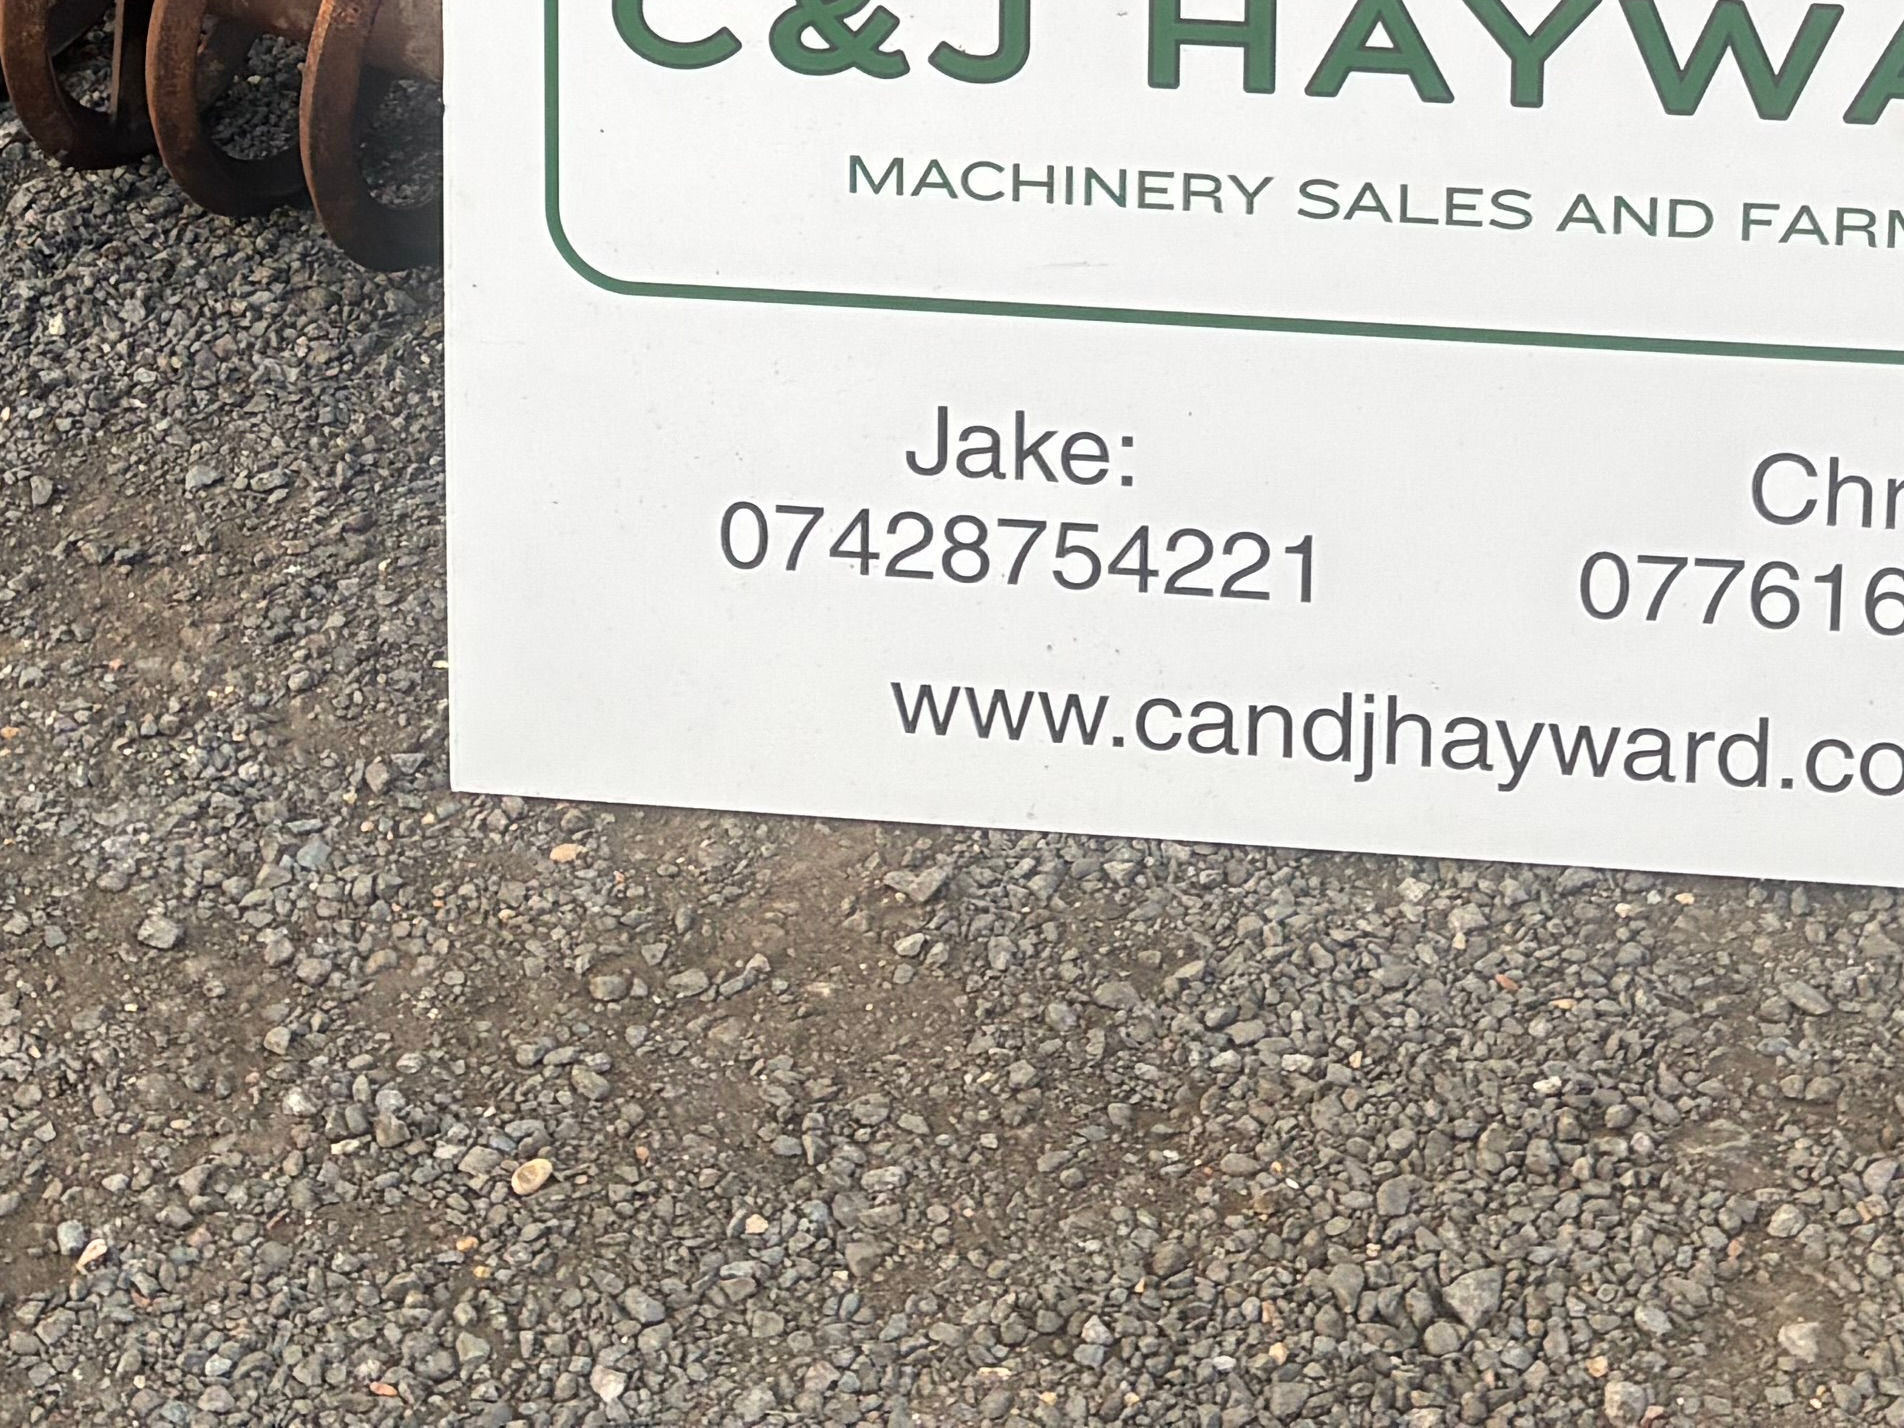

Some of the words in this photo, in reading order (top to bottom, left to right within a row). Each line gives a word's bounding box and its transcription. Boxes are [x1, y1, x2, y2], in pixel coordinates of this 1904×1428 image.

[849, 155, 1274, 215] MACHINERY
[1297, 178, 1533, 230] SALES
[1556, 193, 1714, 239] AND
[905, 405, 1134, 487] Jake:
[720, 501, 1313, 603] 07428754221
